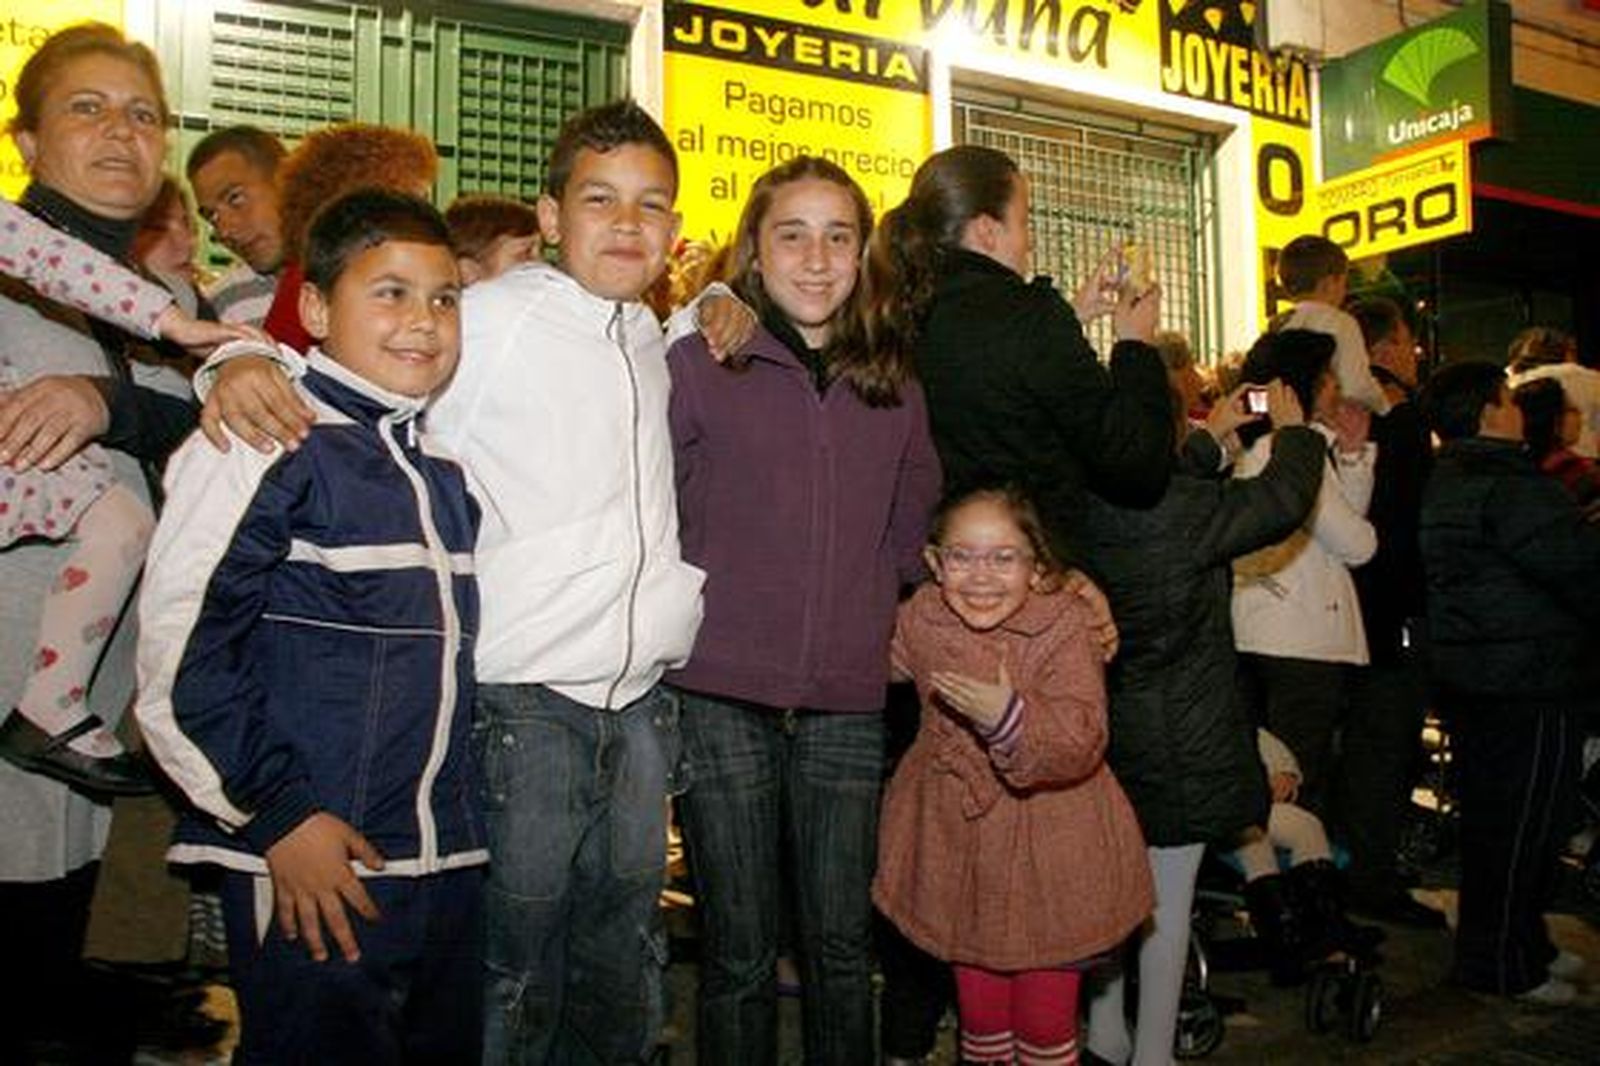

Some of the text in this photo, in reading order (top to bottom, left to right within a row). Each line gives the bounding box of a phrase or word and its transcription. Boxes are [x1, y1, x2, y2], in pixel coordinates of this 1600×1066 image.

[673, 16, 917, 83] JOYERIA
[1162, 29, 1310, 122] JOYERIA
[725, 81, 873, 129] Pagamos
[1387, 99, 1474, 145] Unicaja
[677, 124, 704, 152] al
[710, 172, 737, 200] al
[1322, 182, 1457, 249] ORO
